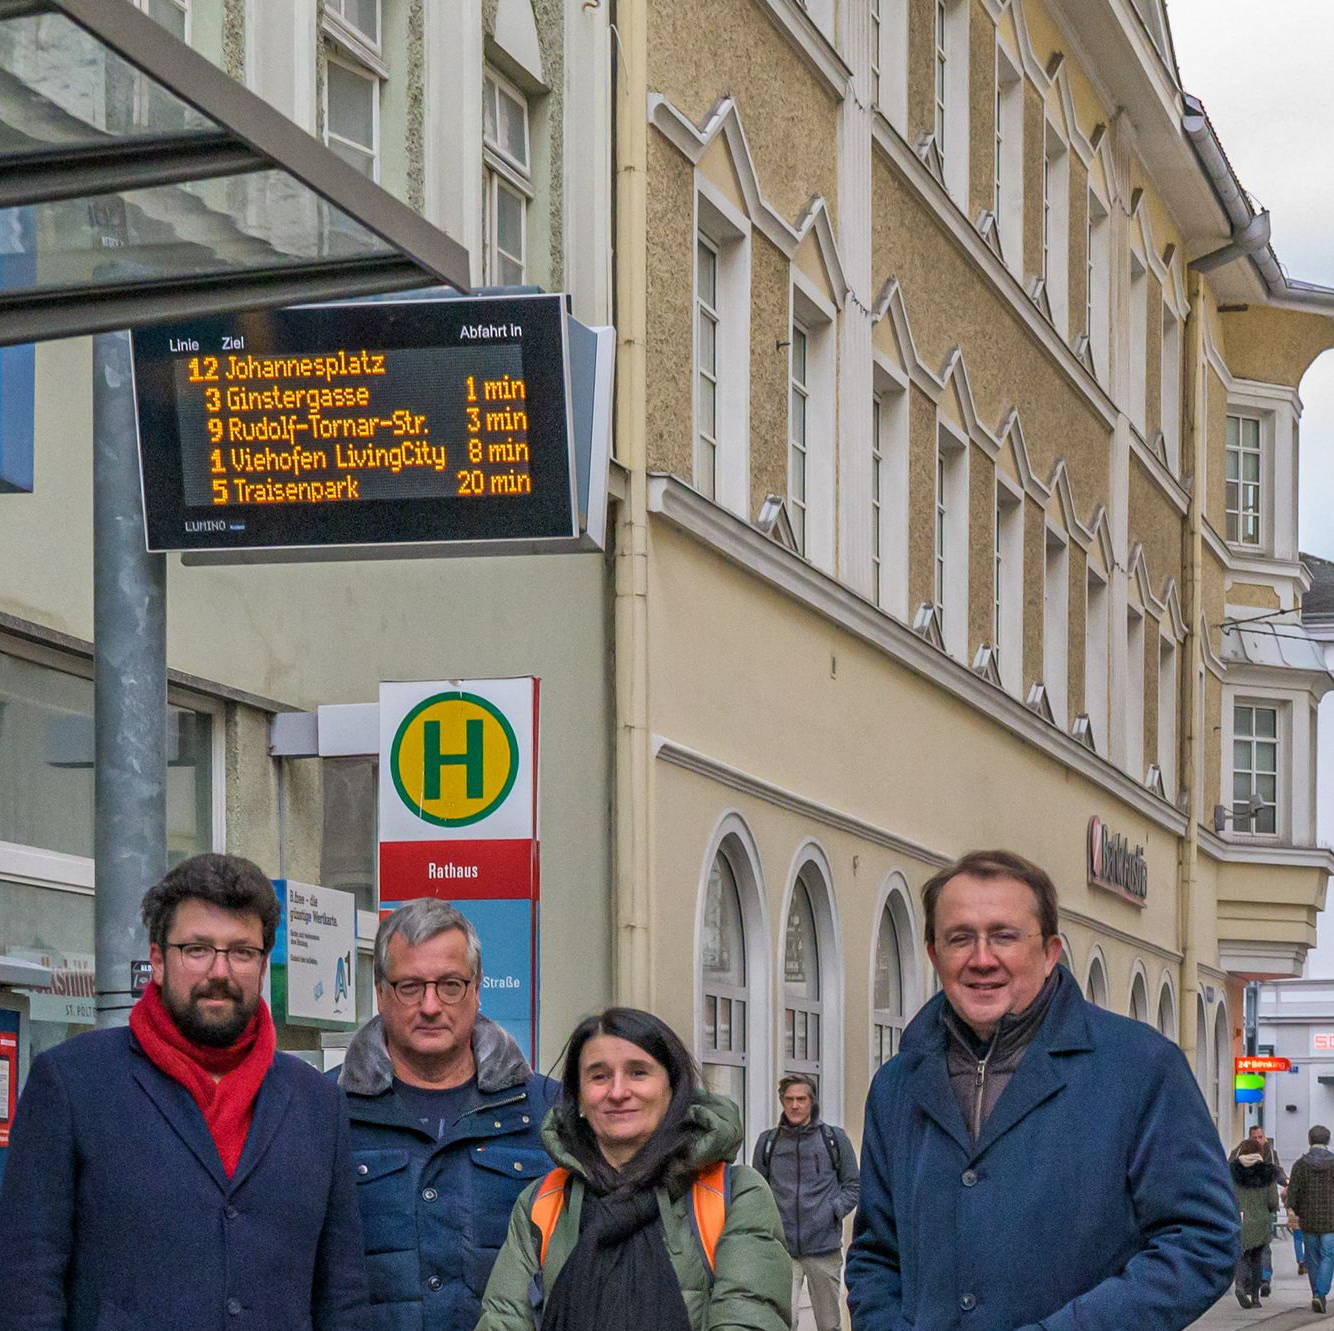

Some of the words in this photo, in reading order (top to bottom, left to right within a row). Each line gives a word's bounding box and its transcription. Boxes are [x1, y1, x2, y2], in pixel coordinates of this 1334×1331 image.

[169, 337, 200, 352] Linie
[221, 336, 245, 351] Ziel
[459, 324, 508, 340] Abfahrt
[509, 323, 523, 338] in
[188, 355, 219, 382] 12
[224, 350, 386, 381] Johannesplatz
[205, 388, 221, 413] 3
[227, 386, 370, 413] Ginstergasse
[465, 376, 477, 402] 1
[484, 376, 526, 401] min
[207, 418, 224, 443] 9
[228, 410, 430, 445] Rudolf-Tornar-Str.
[467, 408, 481, 432] 3
[486, 407, 528, 432] min
[210, 449, 226, 474] 1
[231, 446, 327, 476] Viehofen
[336, 440, 446, 473] LivingCity
[468, 439, 483, 463] 8
[489, 438, 530, 463] min
[212, 481, 228, 505] 5
[234, 475, 360, 503] Traisenpark
[457, 470, 485, 495] 20
[490, 469, 531, 494] min
[424, 719, 484, 800] H
[428, 862, 479, 880] Rathaus
[482, 975, 521, 989] Straße
